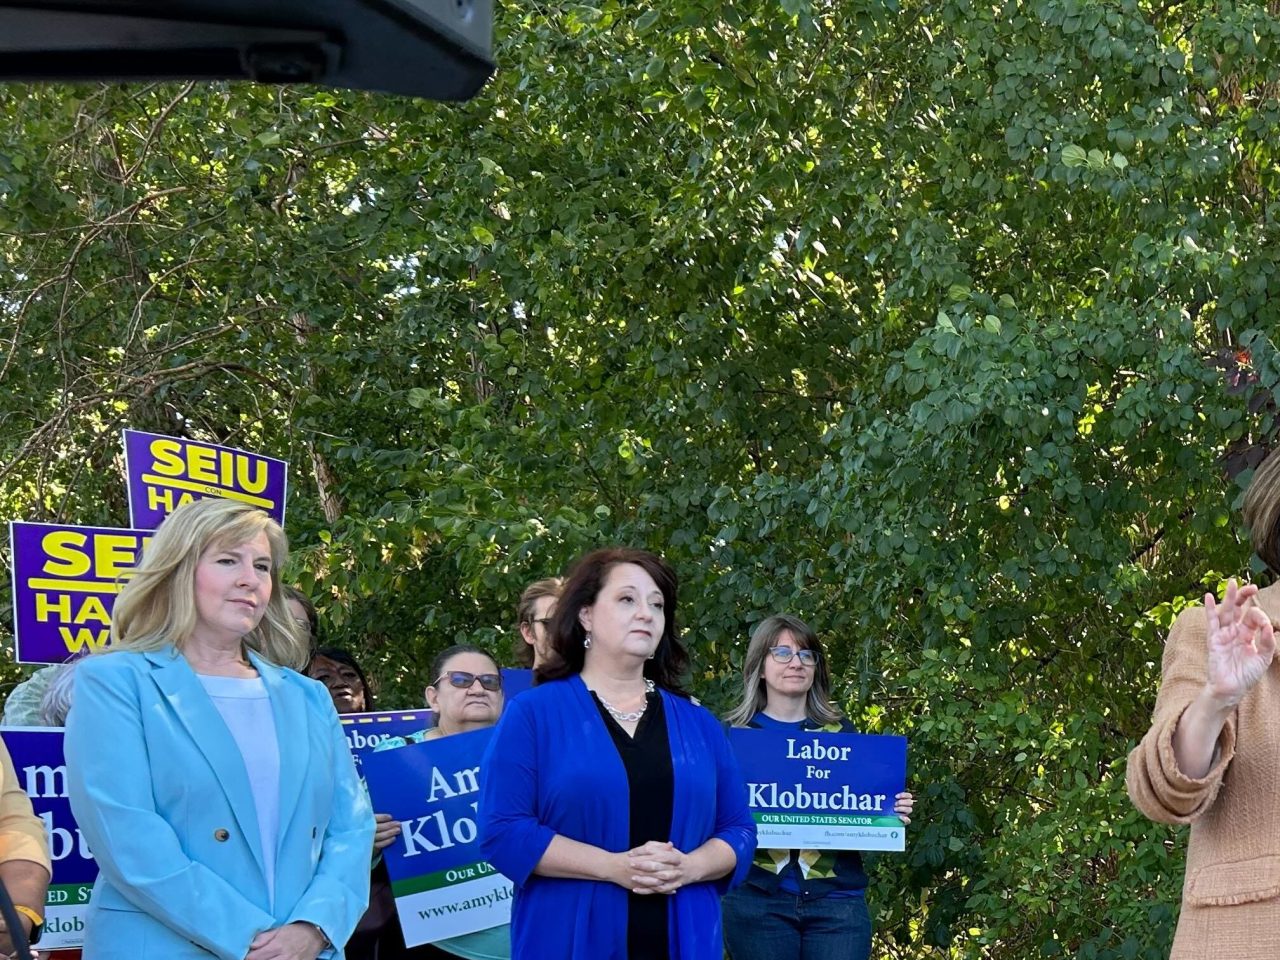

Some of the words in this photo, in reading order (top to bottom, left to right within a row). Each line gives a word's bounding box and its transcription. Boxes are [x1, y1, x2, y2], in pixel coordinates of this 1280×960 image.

[150, 439, 268, 494] SEIU
[42, 531, 153, 579] SE
[786, 739, 851, 760] Labor
[806, 766, 831, 779] For
[747, 782, 886, 811] Klobuchar
[400, 801, 478, 857] Klo
